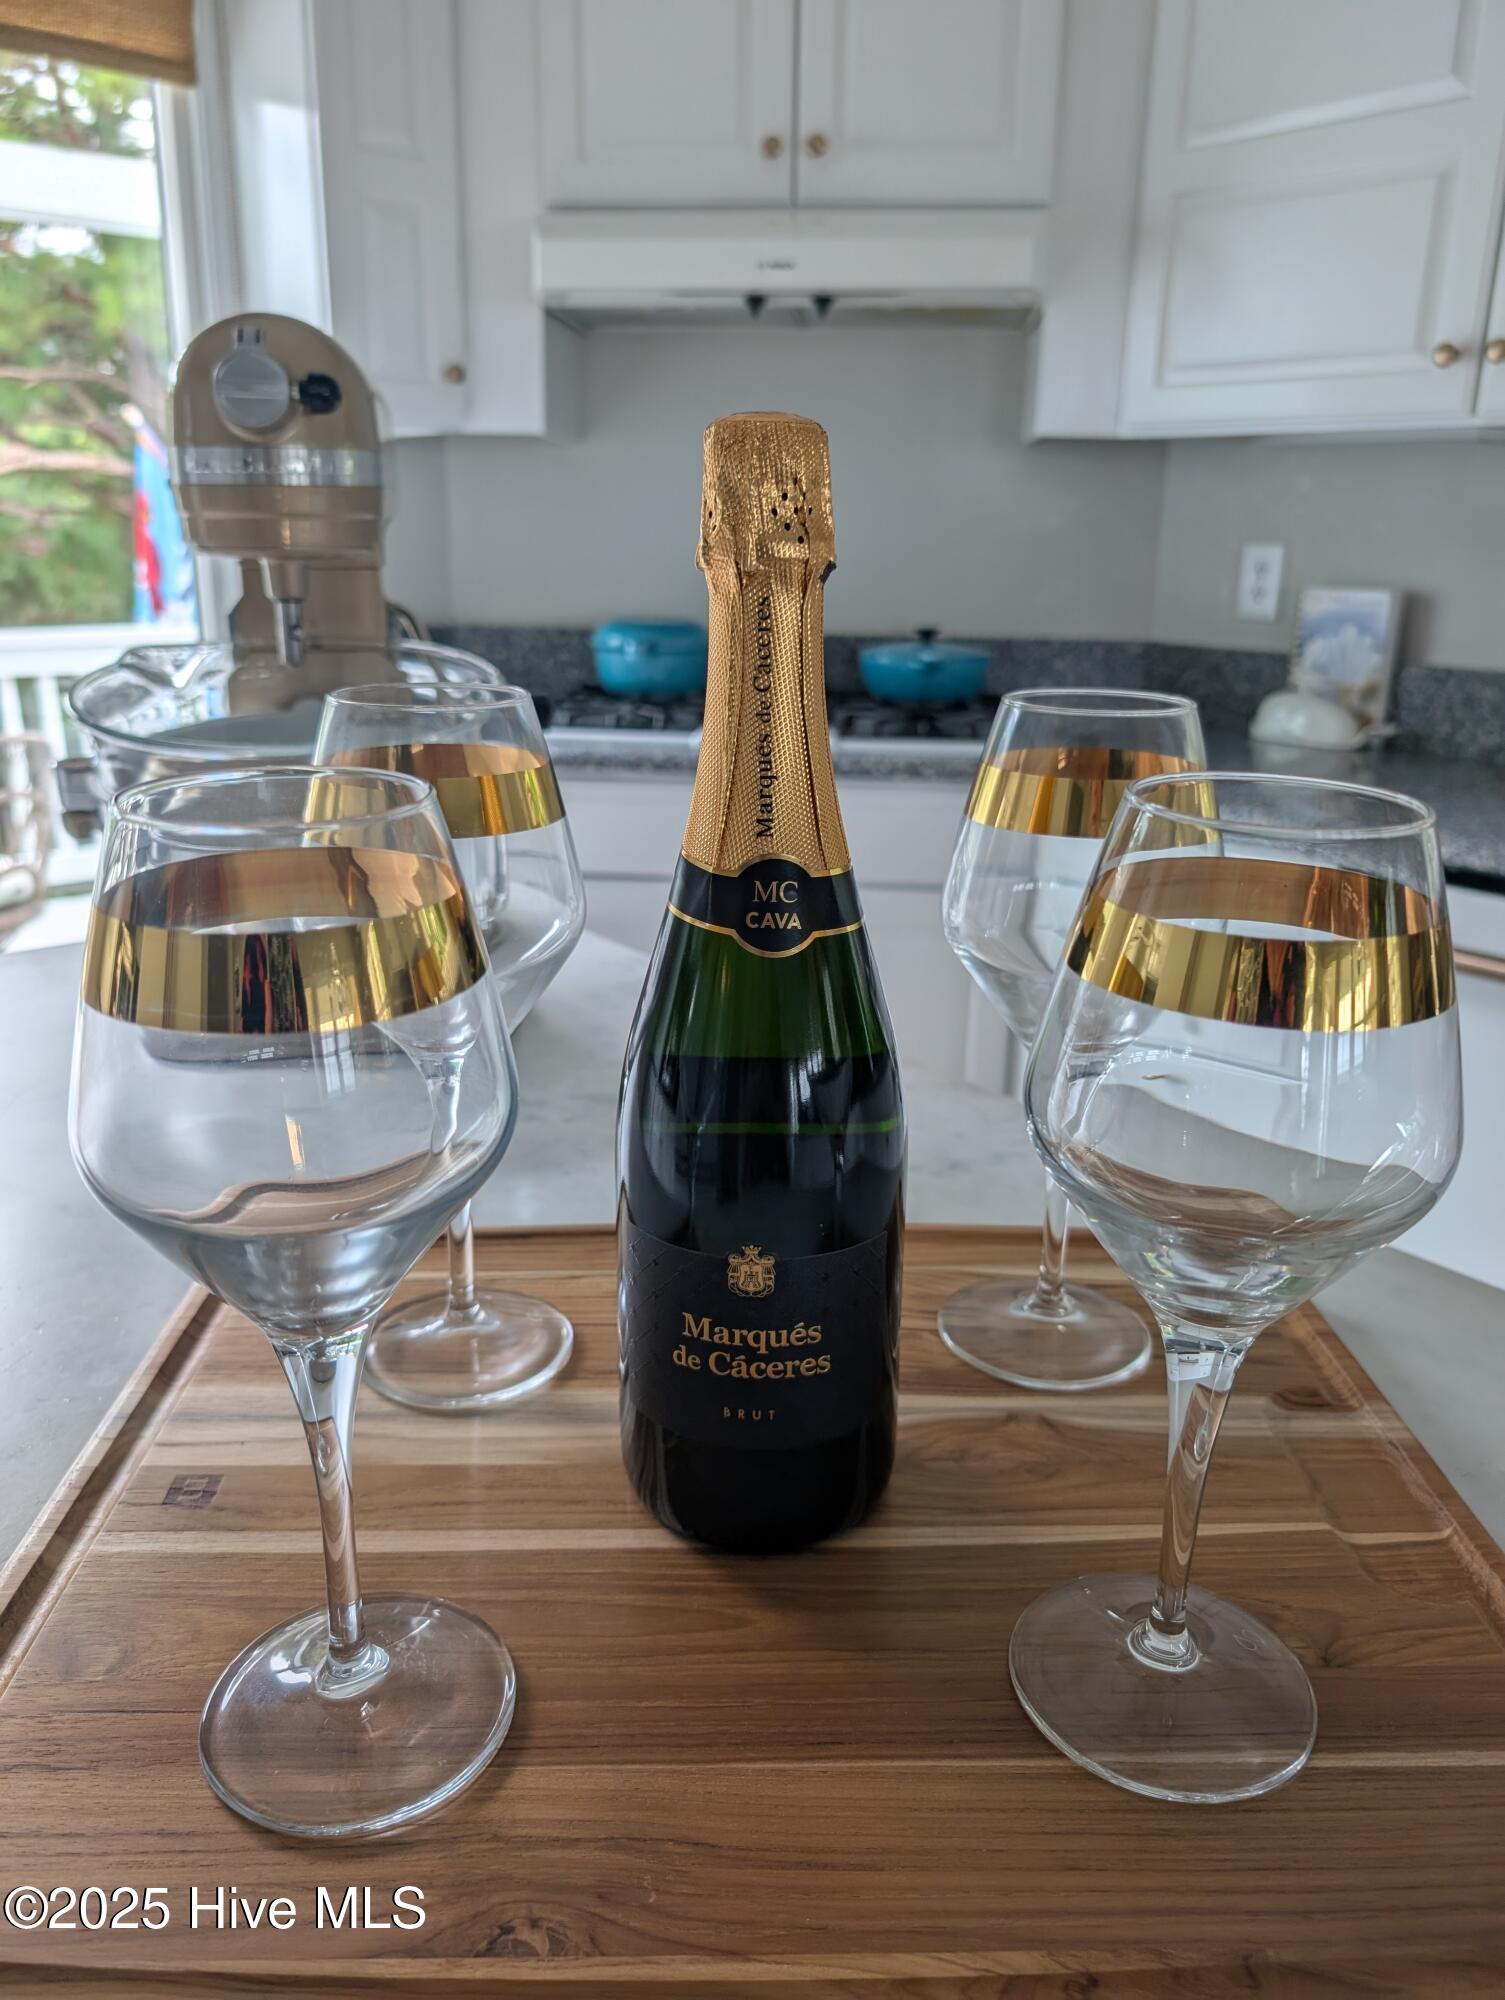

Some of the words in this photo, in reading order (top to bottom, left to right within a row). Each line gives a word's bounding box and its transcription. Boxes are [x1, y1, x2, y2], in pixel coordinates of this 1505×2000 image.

[755, 702, 772, 723] de
[752, 880, 799, 903] MC
[745, 911, 802, 930] CAVA
[682, 1311, 823, 1355] Marqués
[672, 1344, 701, 1370] de
[708, 1350, 832, 1380] Cáceres
[723, 1406, 776, 1421] BRUT
